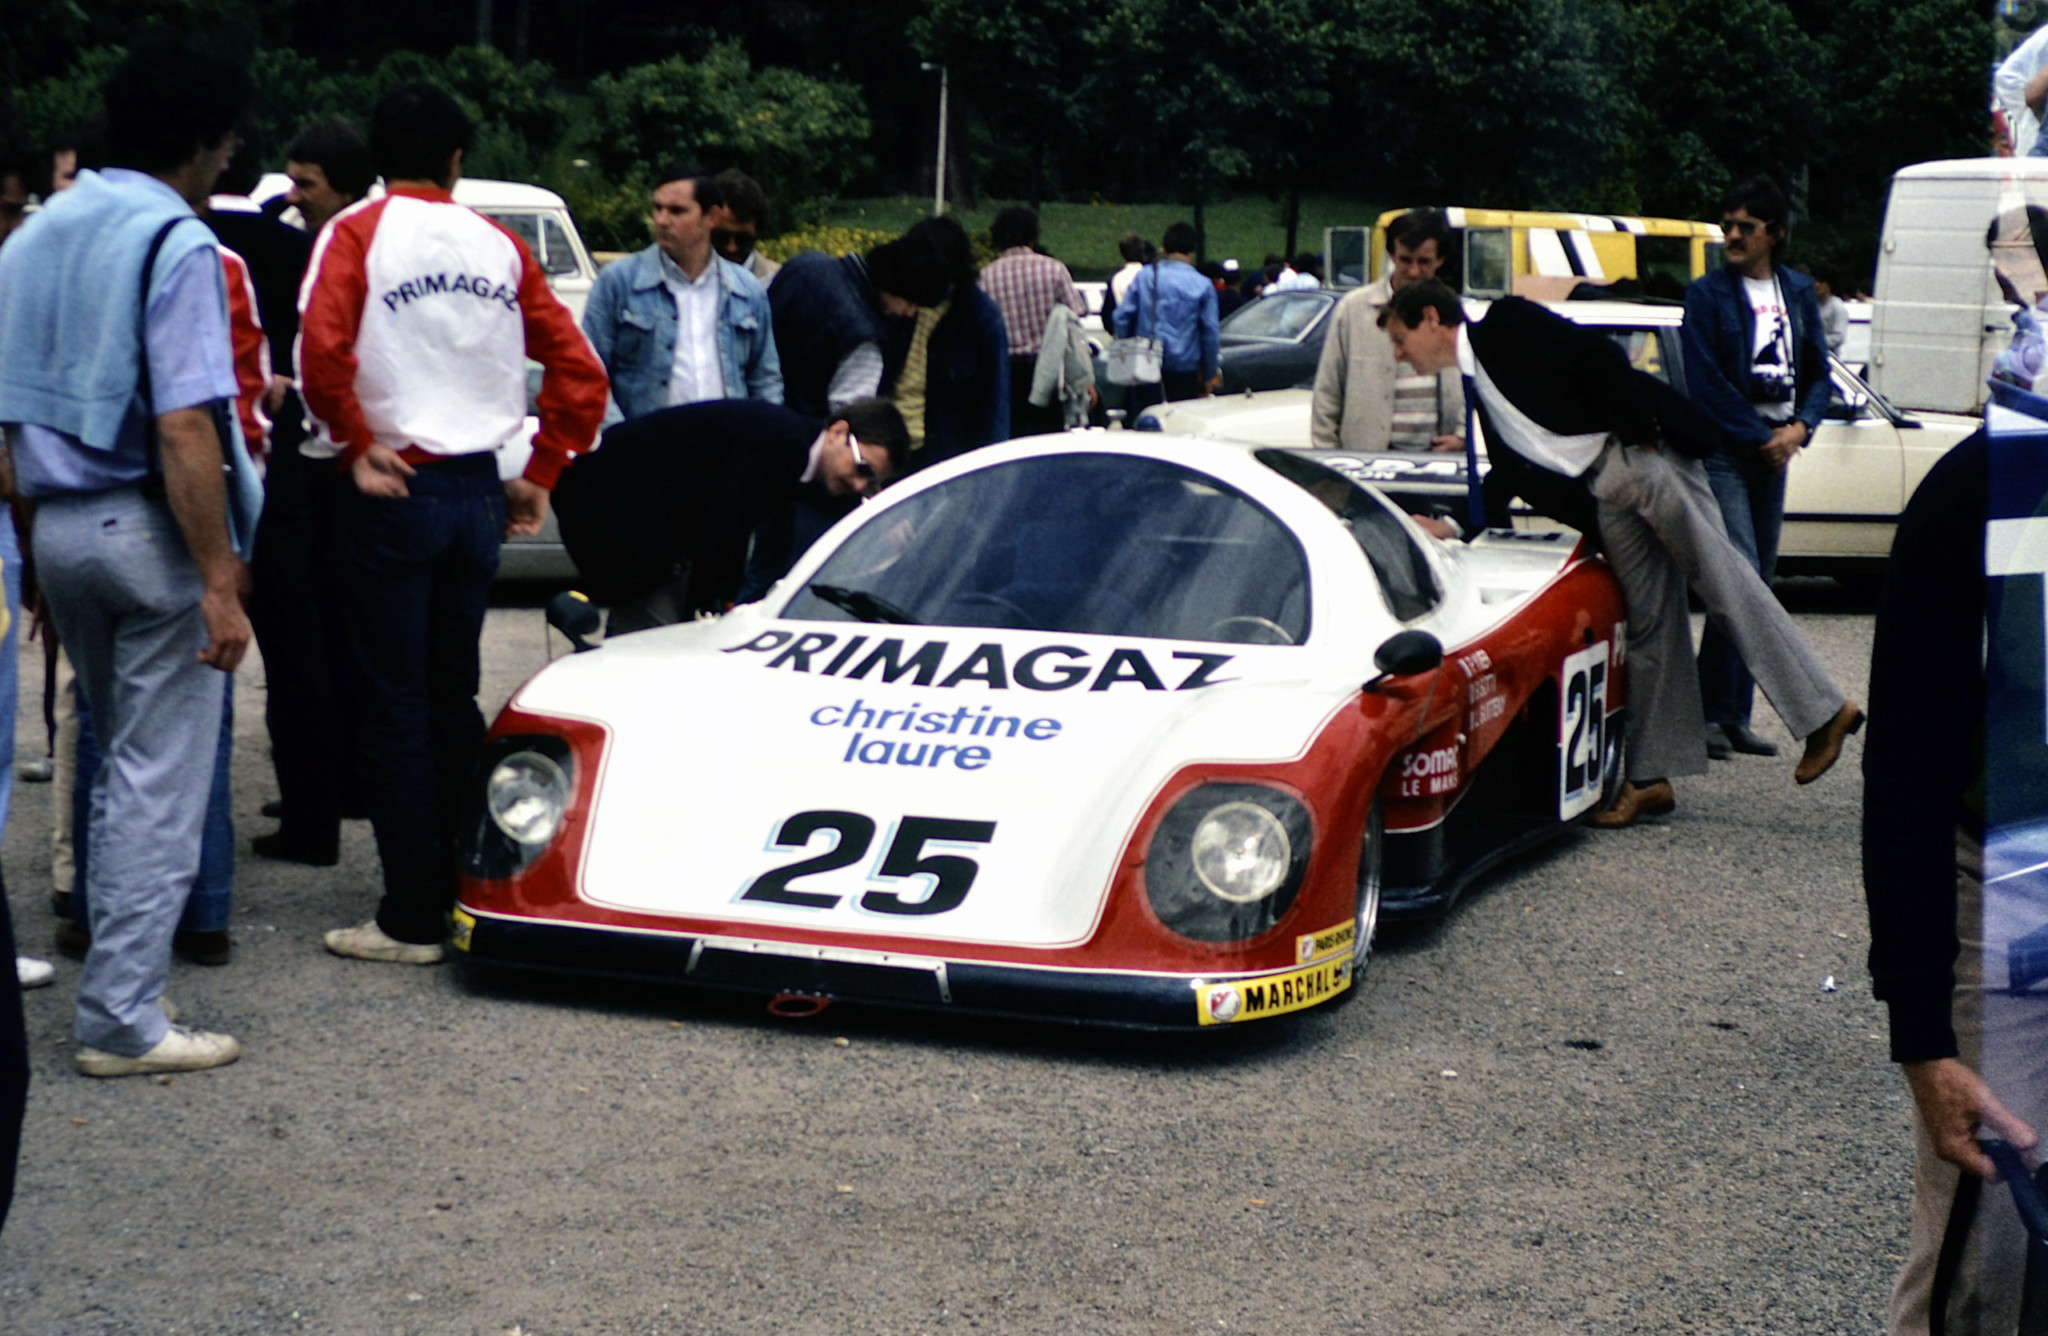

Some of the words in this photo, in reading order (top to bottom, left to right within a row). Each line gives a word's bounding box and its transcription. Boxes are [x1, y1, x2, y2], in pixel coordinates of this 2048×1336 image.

[382, 273, 519, 312] PRIMAGAZ
[720, 630, 1242, 692] PRIMAGAZ
[809, 700, 1063, 741] christine
[1565, 661, 1605, 794] 25
[843, 733, 992, 770] laure
[1402, 780, 1420, 797] LE
[1430, 771, 1459, 795] MANS
[735, 810, 998, 916] 25
[1245, 968, 1330, 1013] MARCHAL
